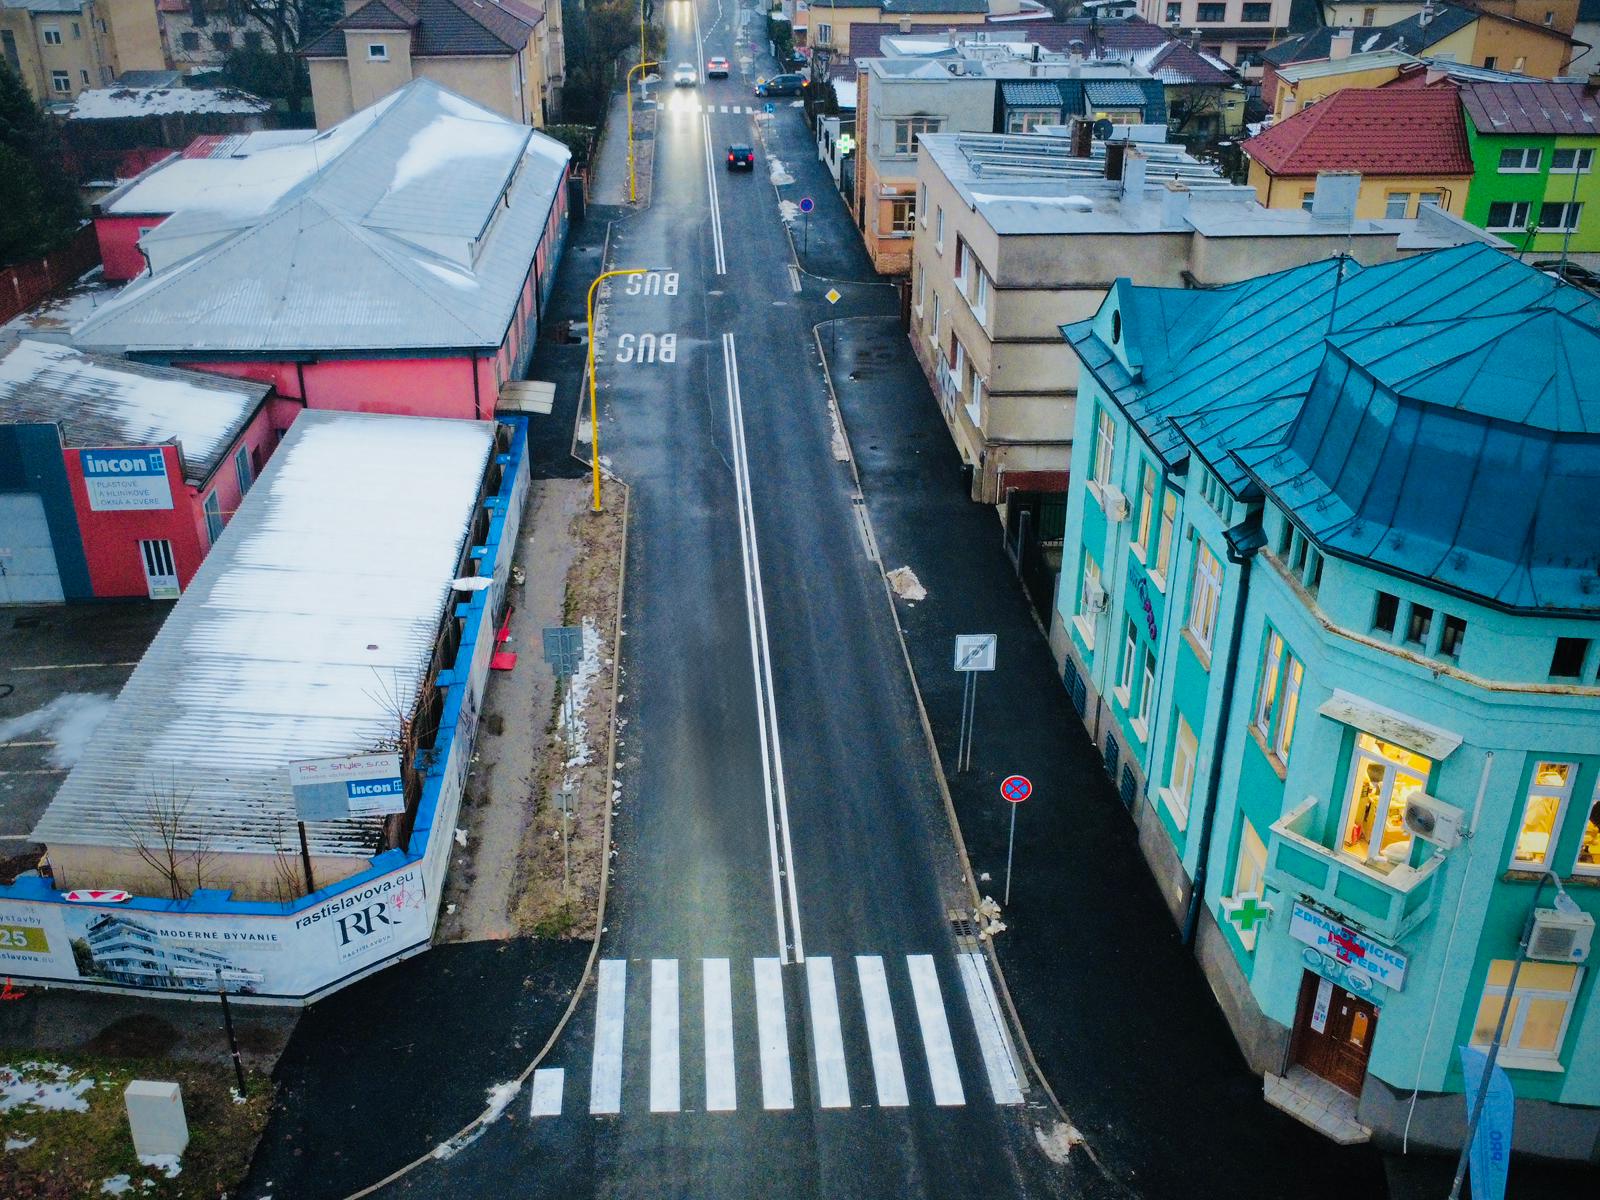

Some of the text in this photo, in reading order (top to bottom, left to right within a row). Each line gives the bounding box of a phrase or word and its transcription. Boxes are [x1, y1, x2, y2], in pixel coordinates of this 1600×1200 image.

[626, 272, 679, 296] BUS
[616, 333, 677, 363] BUS
[86, 455, 147, 472] incon
[299, 765, 317, 773] PR
[351, 783, 391, 795] incon
[296, 872, 414, 929] rastislavova.eu
[336, 902, 401, 946] RR
